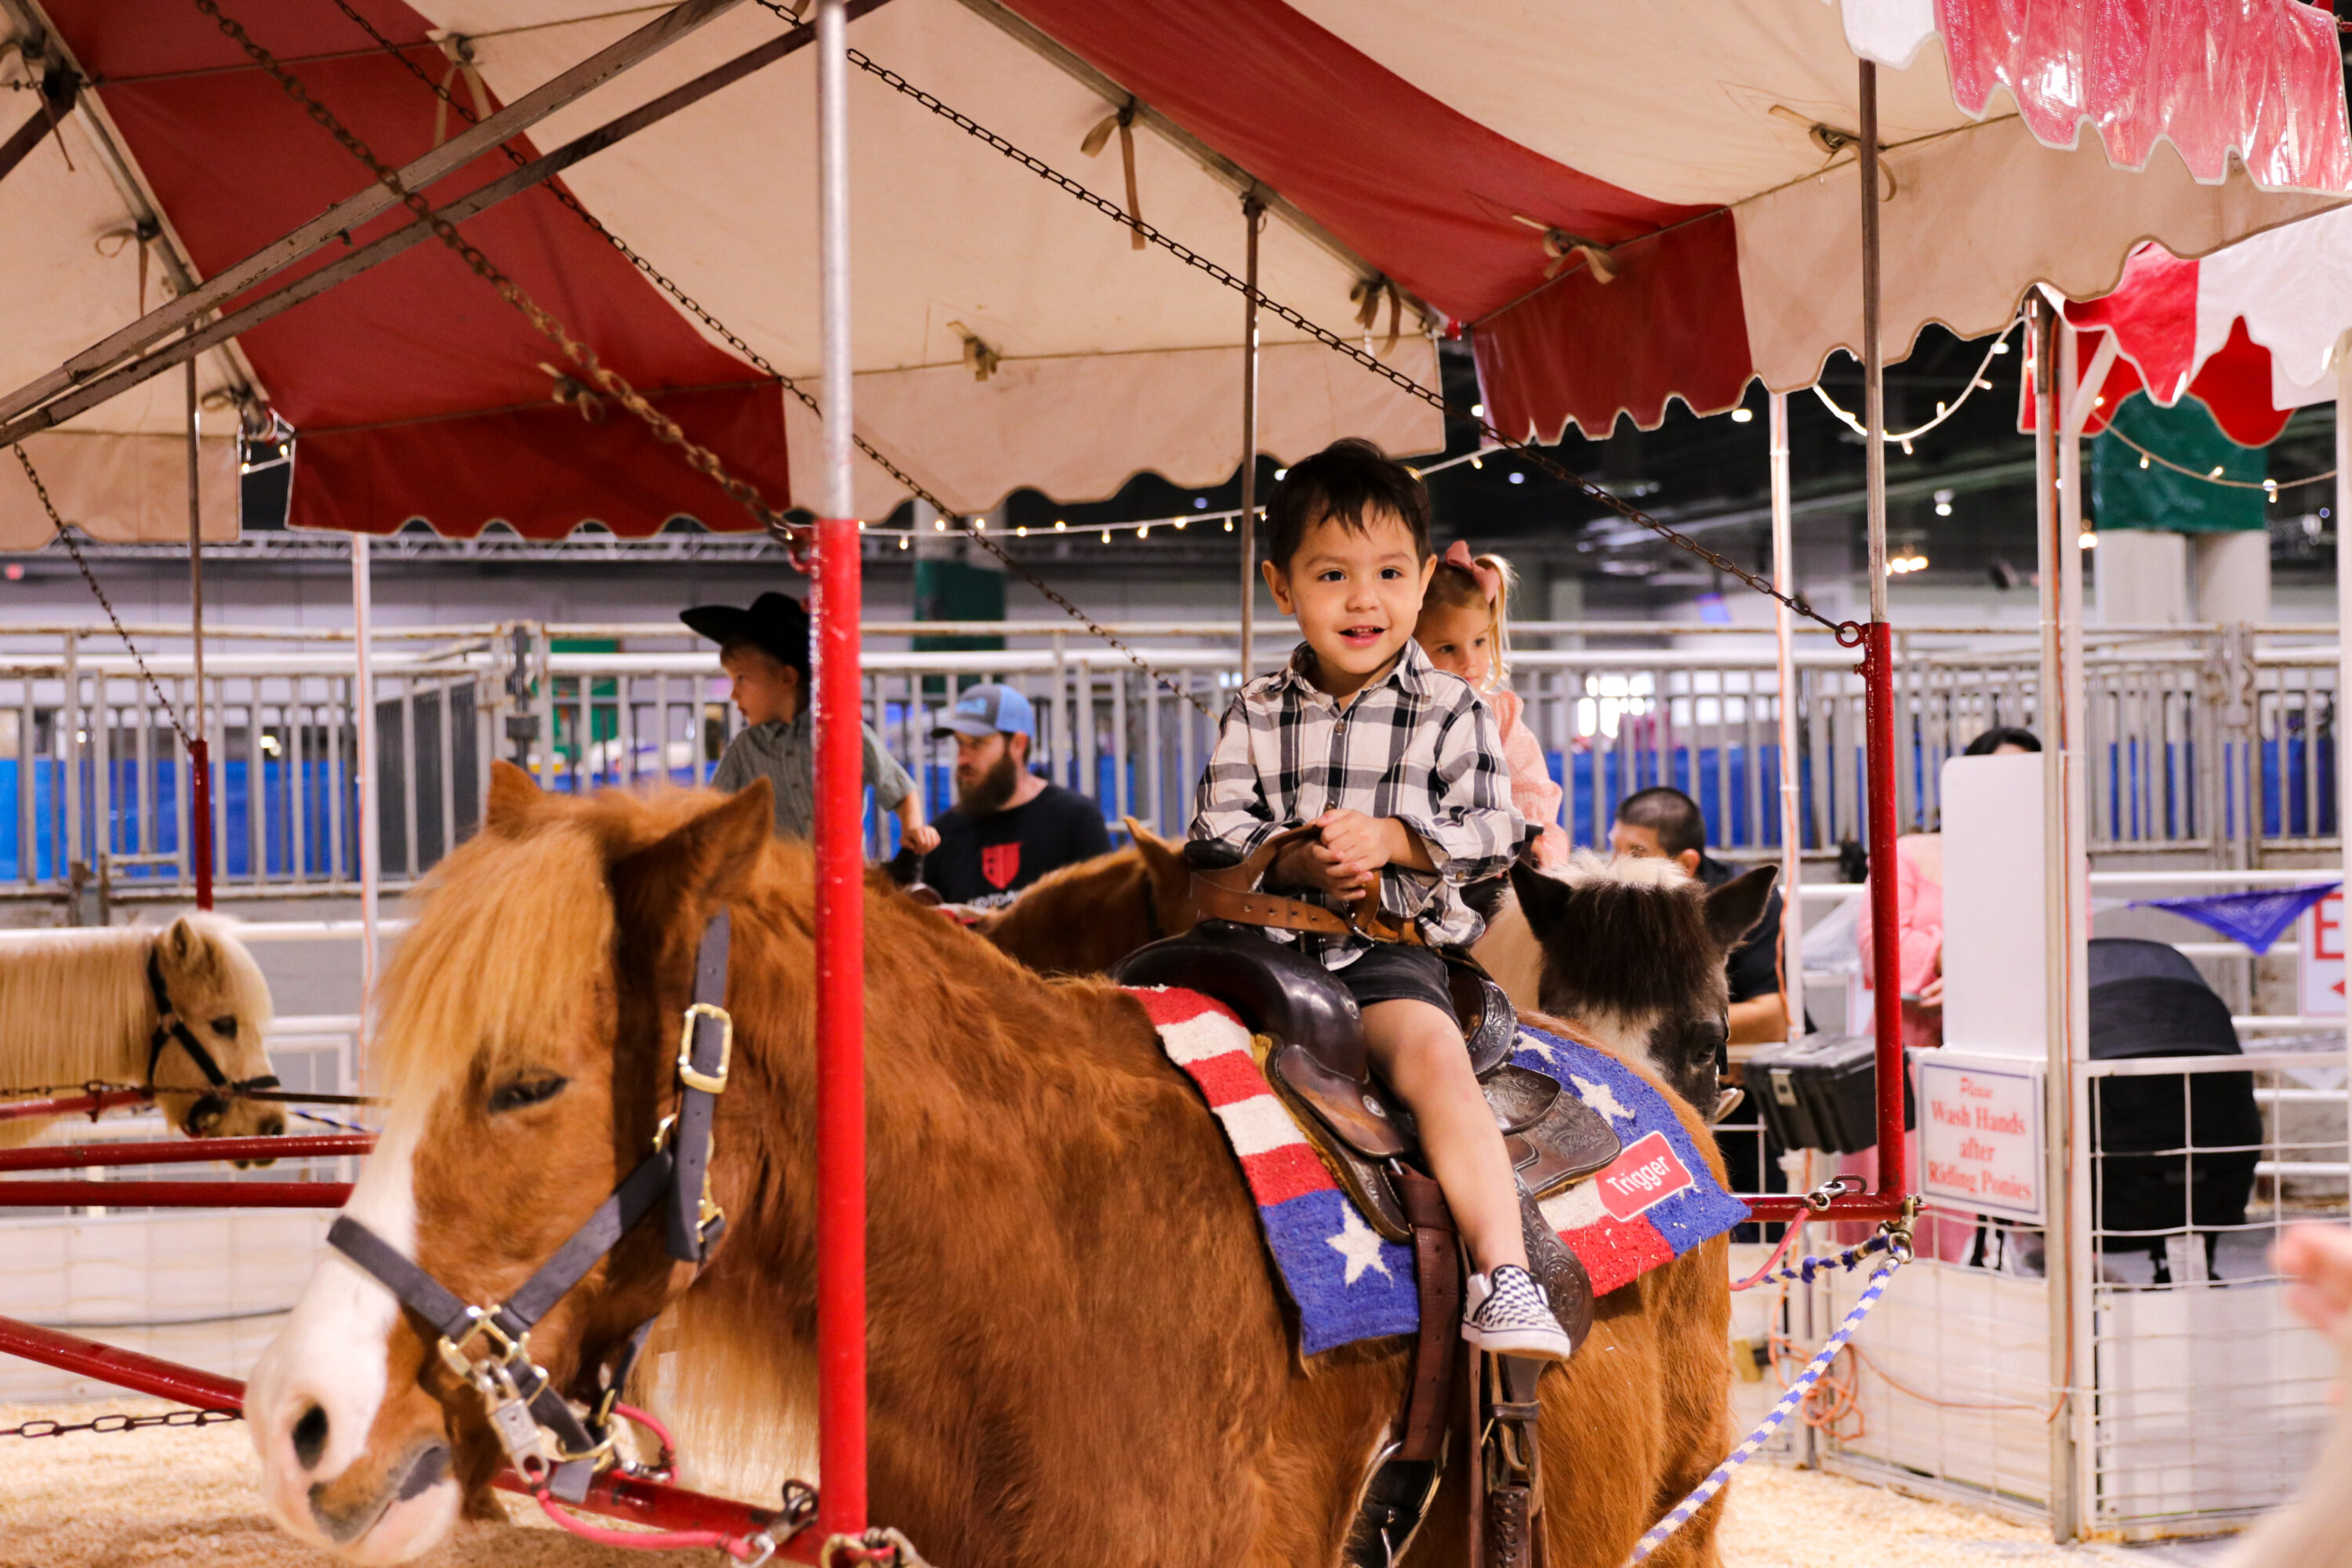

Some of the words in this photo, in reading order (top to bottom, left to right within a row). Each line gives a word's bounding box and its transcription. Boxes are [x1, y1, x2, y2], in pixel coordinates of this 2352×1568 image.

[1930, 1100, 1972, 1127] Wash
[1976, 1106, 2027, 1135] Hands
[1960, 1137, 1996, 1163] after
[1606, 1156, 1671, 1196] Trigger
[1928, 1160, 1977, 1195] Riding
[1981, 1169, 2033, 1201] Ponies
